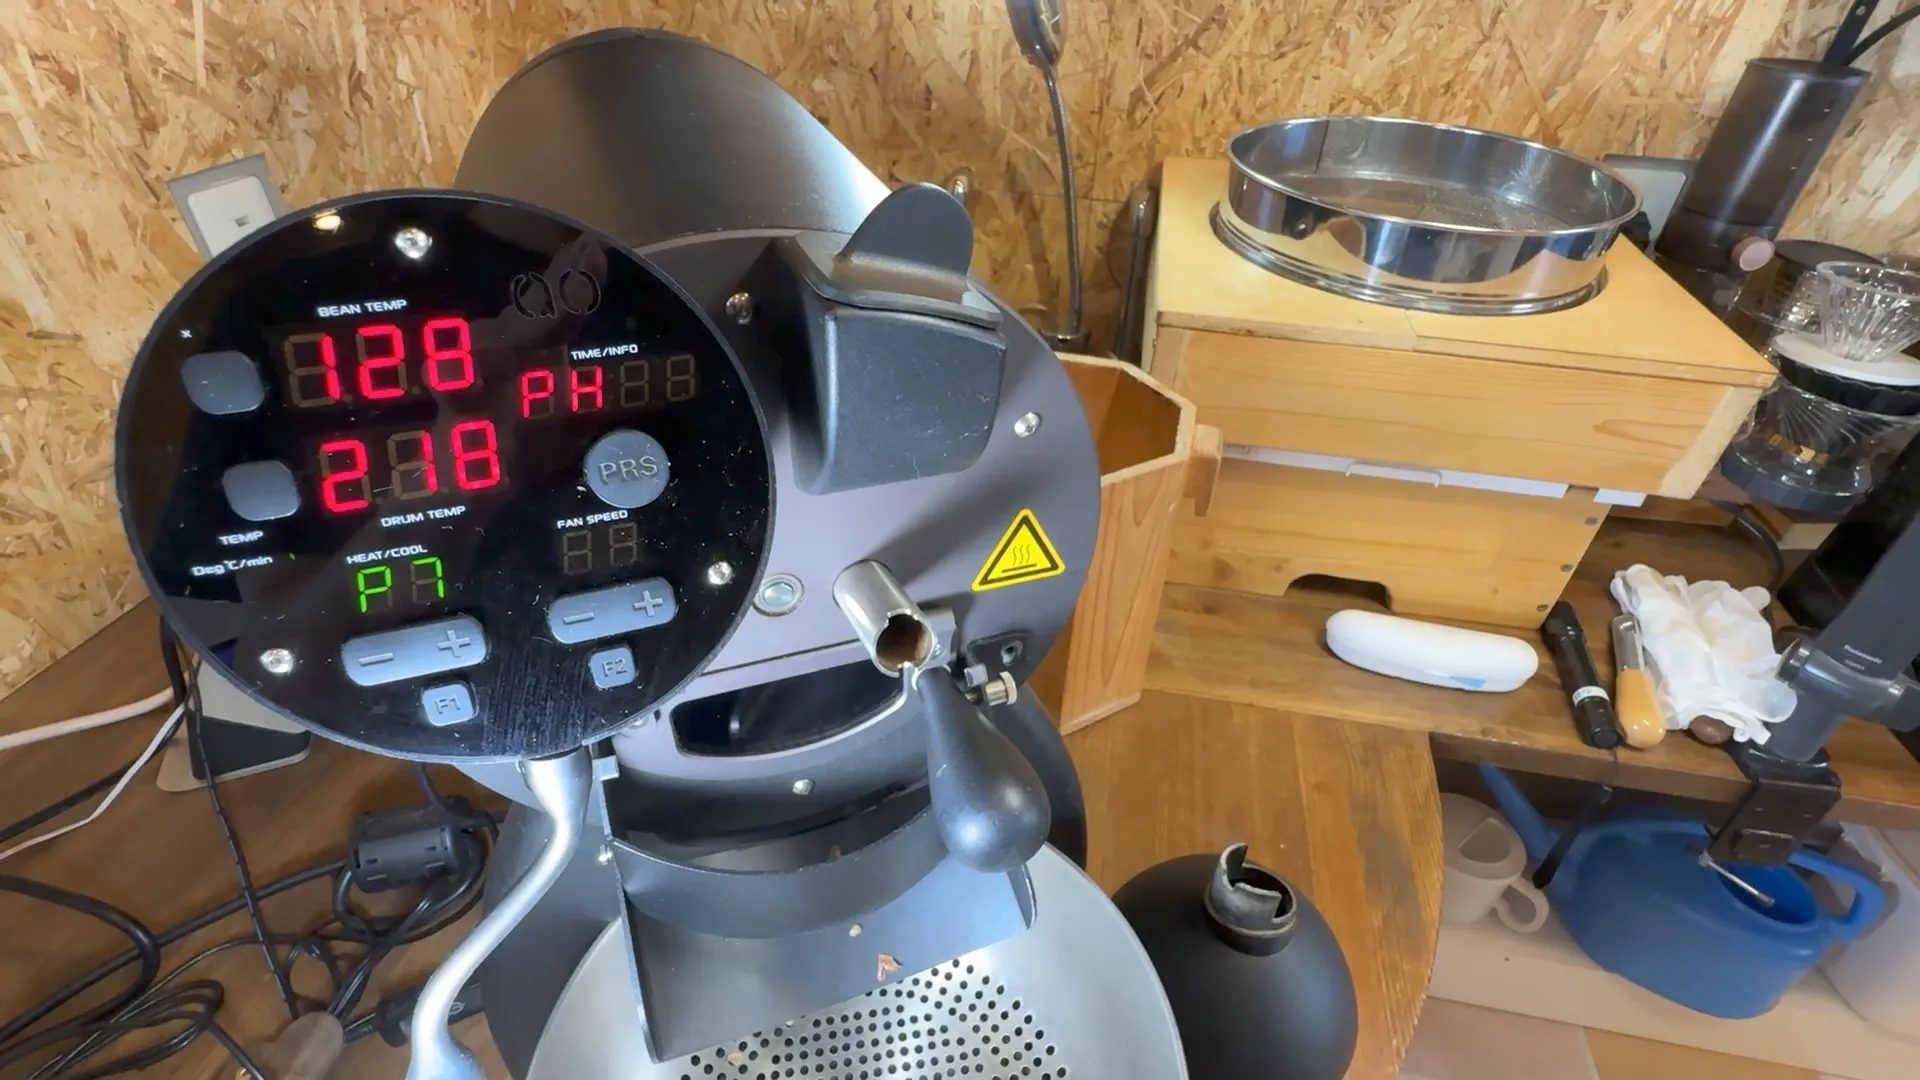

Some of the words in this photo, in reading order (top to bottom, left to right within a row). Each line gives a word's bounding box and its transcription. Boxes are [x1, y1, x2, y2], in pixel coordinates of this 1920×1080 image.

[317, 303, 361, 318] BEAN
[365, 299, 408, 312] TEMP
[319, 317, 475, 401] 128
[570, 344, 639, 361] TIME/INFO
[520, 364, 603, 419] PH
[320, 419, 501, 513] 218
[599, 455, 658, 485] PRS
[380, 512, 425, 528] DRUM
[427, 505, 467, 520] TEMP
[557, 516, 584, 529] FAN
[586, 509, 629, 525] SPEED
[218, 530, 264, 546] TEMP
[346, 544, 429, 565] HEAT/COOL
[356, 556, 445, 613] P7
[601, 657, 629, 678] F2
[433, 695, 461, 716] F1
